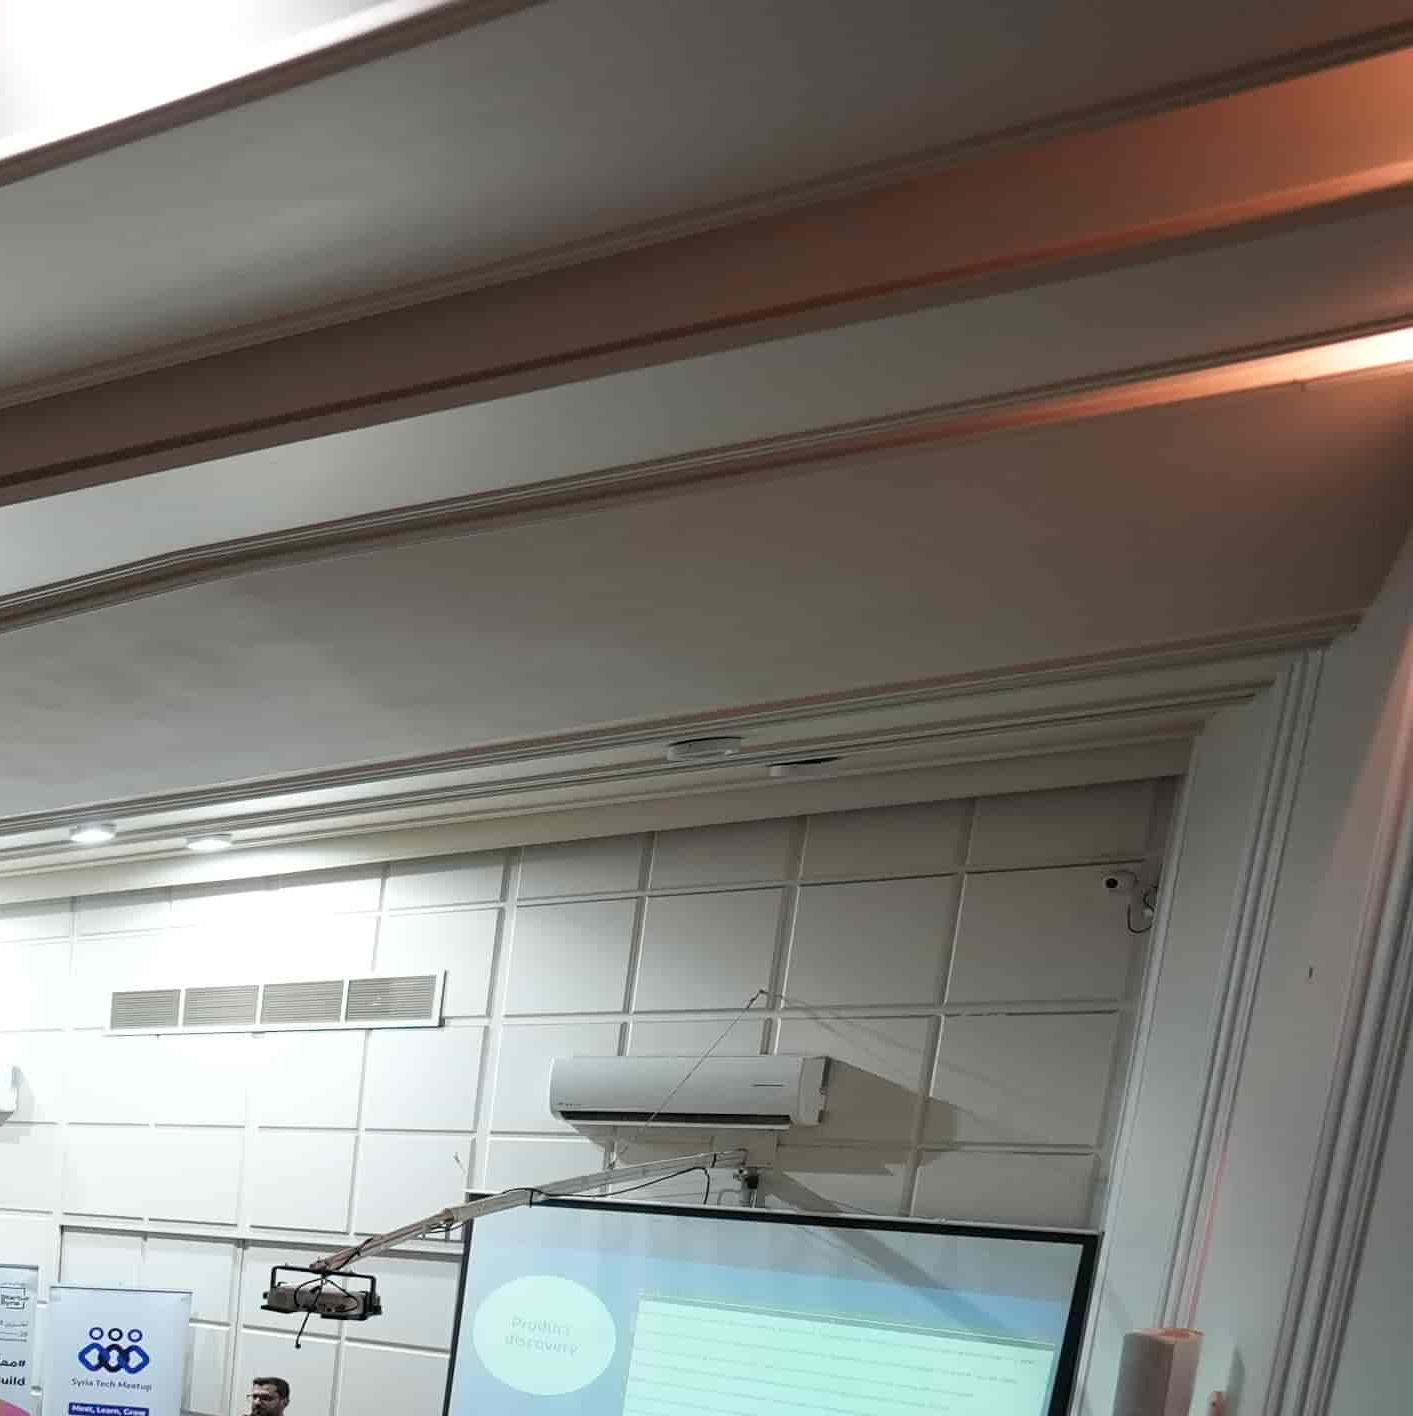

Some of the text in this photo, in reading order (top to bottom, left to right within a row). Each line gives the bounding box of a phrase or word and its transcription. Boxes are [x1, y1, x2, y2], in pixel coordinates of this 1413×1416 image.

[71, 1378, 152, 1392] Syria Tech Meetup
[71, 1404, 147, 1416] Meet, Learn, Grow
